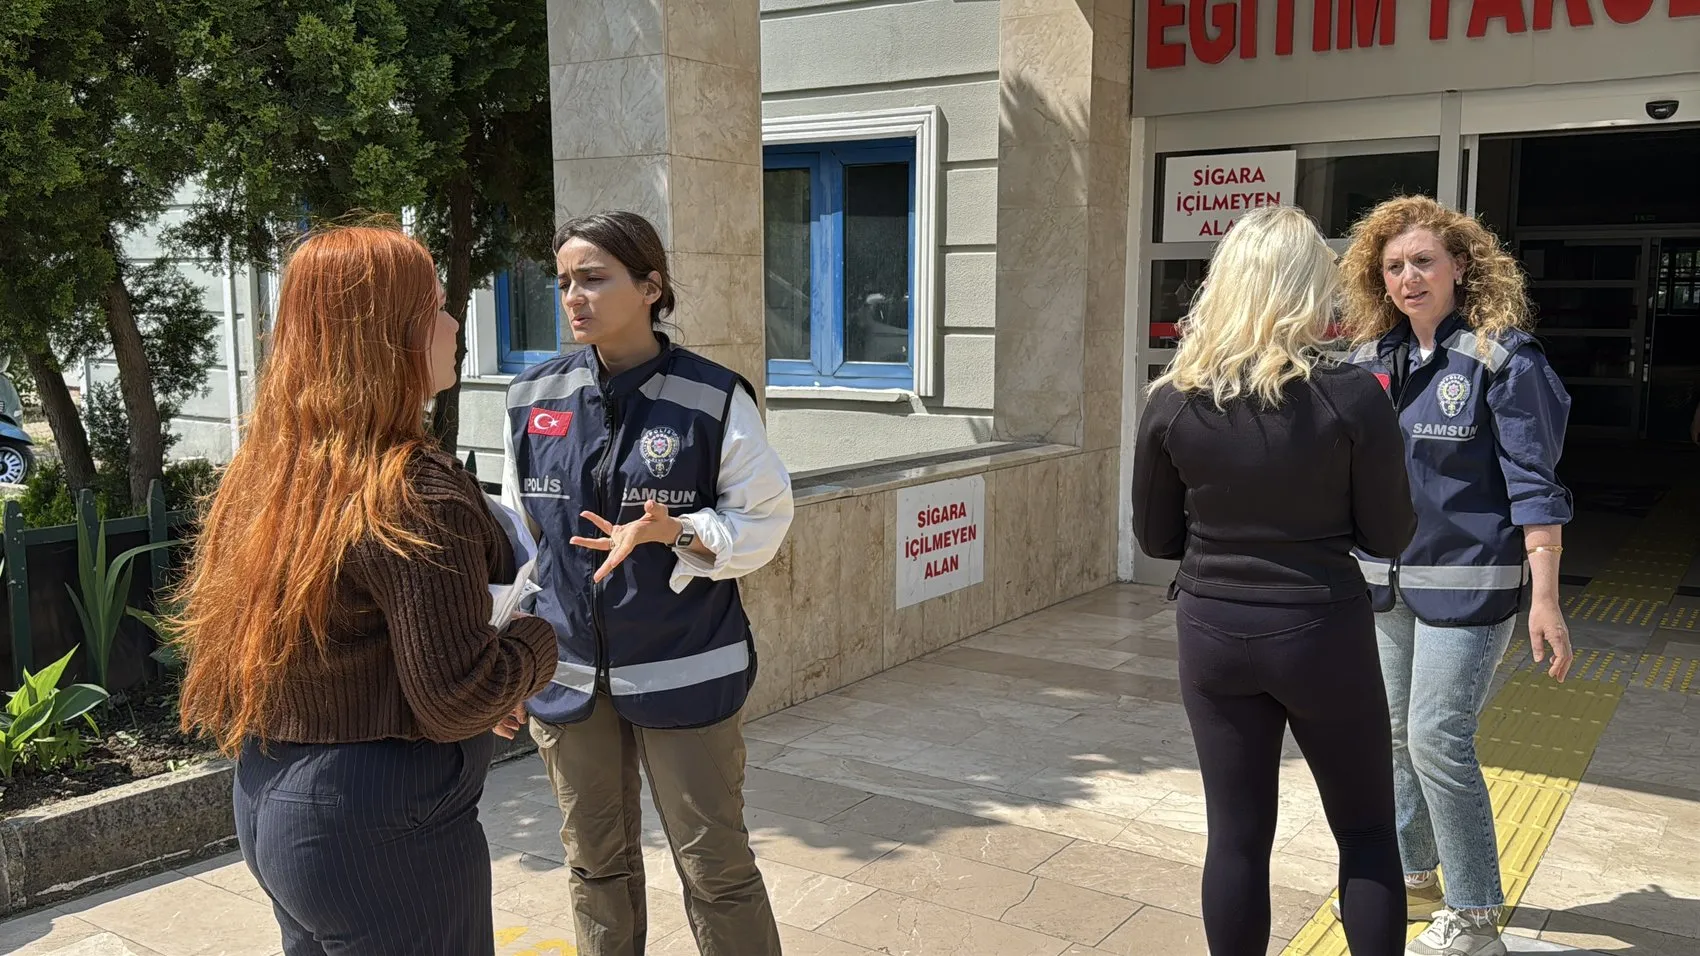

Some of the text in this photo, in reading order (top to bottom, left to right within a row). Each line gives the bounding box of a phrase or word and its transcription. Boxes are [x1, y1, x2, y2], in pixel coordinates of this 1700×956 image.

[1193, 164, 1266, 187] SİGARA
[1176, 191, 1281, 217] İÇİLMEYEN
[1412, 422, 1479, 438] SAMSUN
[523, 474, 562, 493] POLİS
[917, 501, 967, 529] SİGARA
[905, 524, 977, 562] İÇİLMEYEN
[924, 554, 959, 580] ALAN
